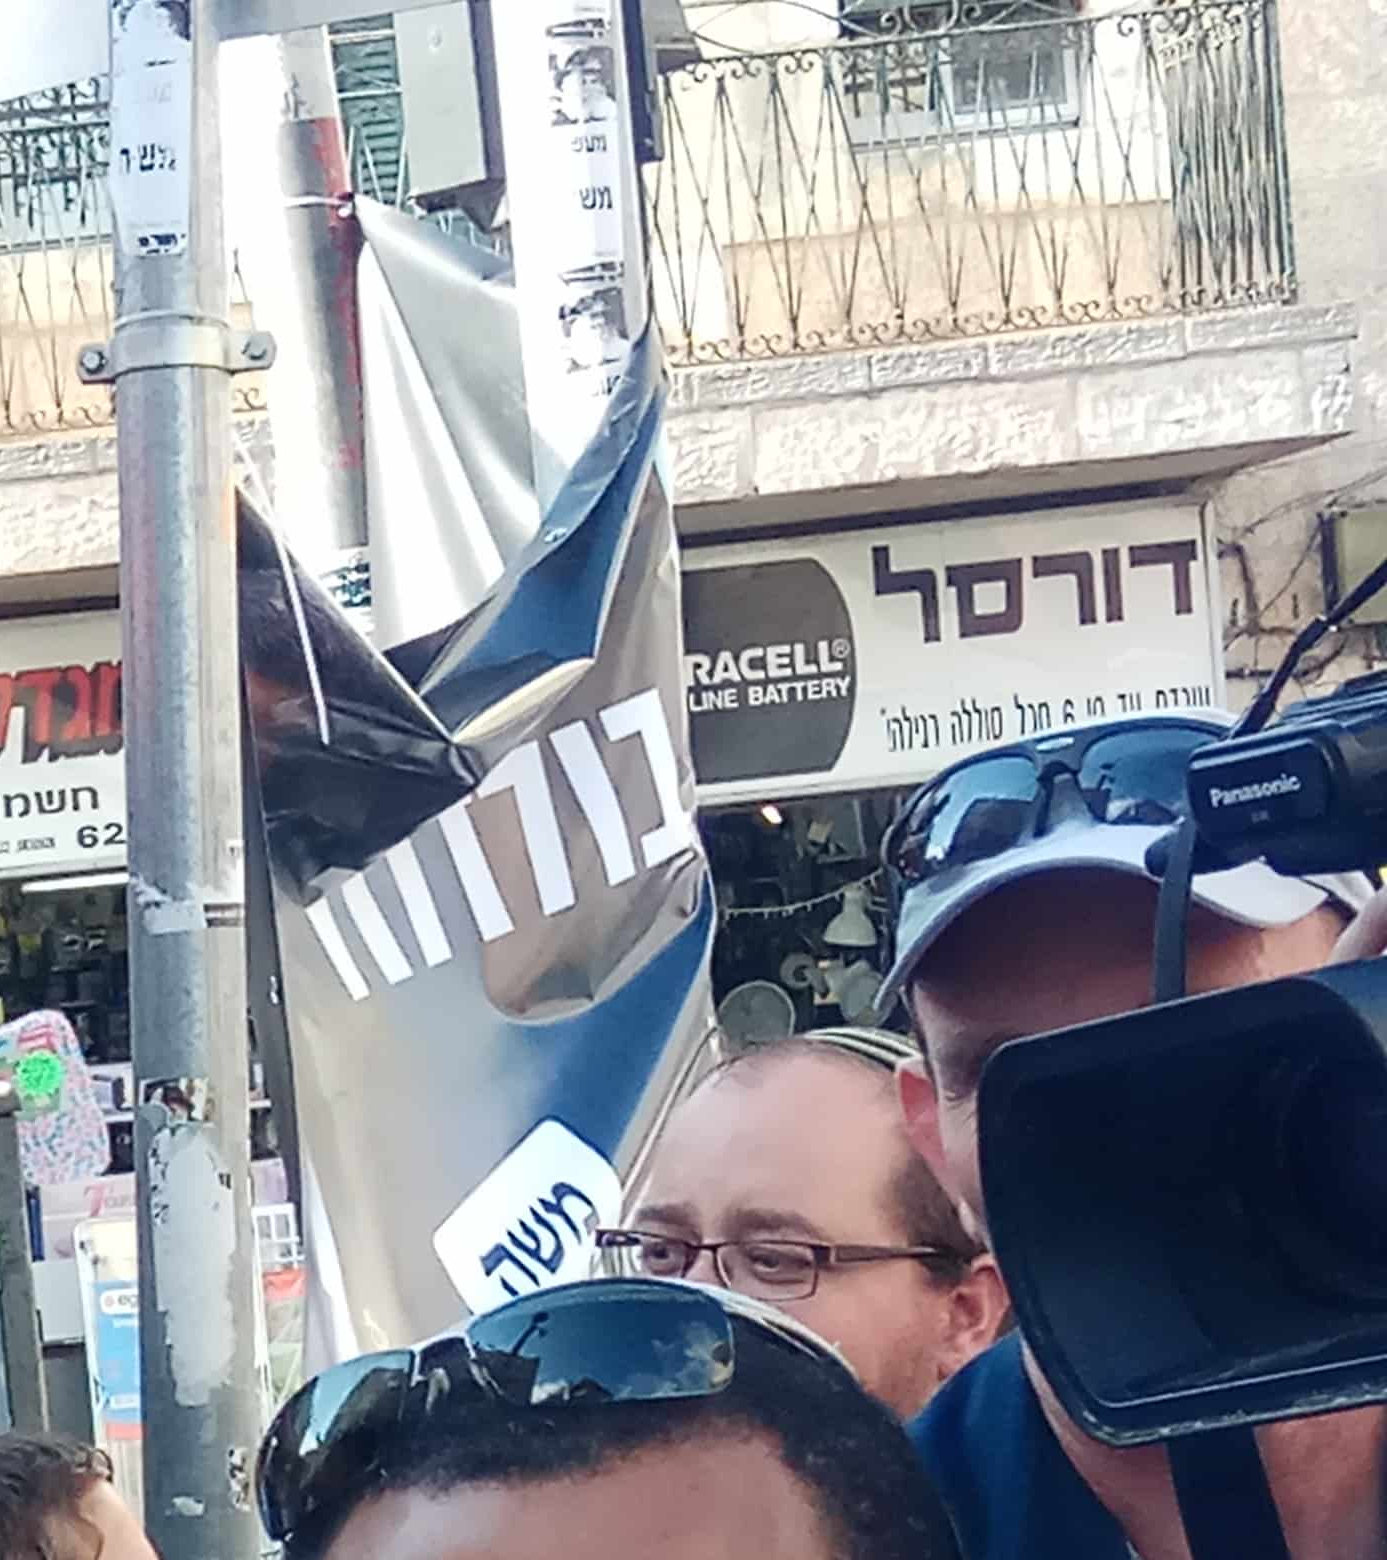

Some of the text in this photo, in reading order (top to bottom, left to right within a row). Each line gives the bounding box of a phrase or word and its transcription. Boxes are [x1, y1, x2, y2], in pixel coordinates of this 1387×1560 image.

[872, 539, 1197, 643] דורסל
[689, 675, 851, 712] LINE BATTERY
[1210, 773, 1303, 808] Panasonic
[481, 1182, 600, 1297] משה
